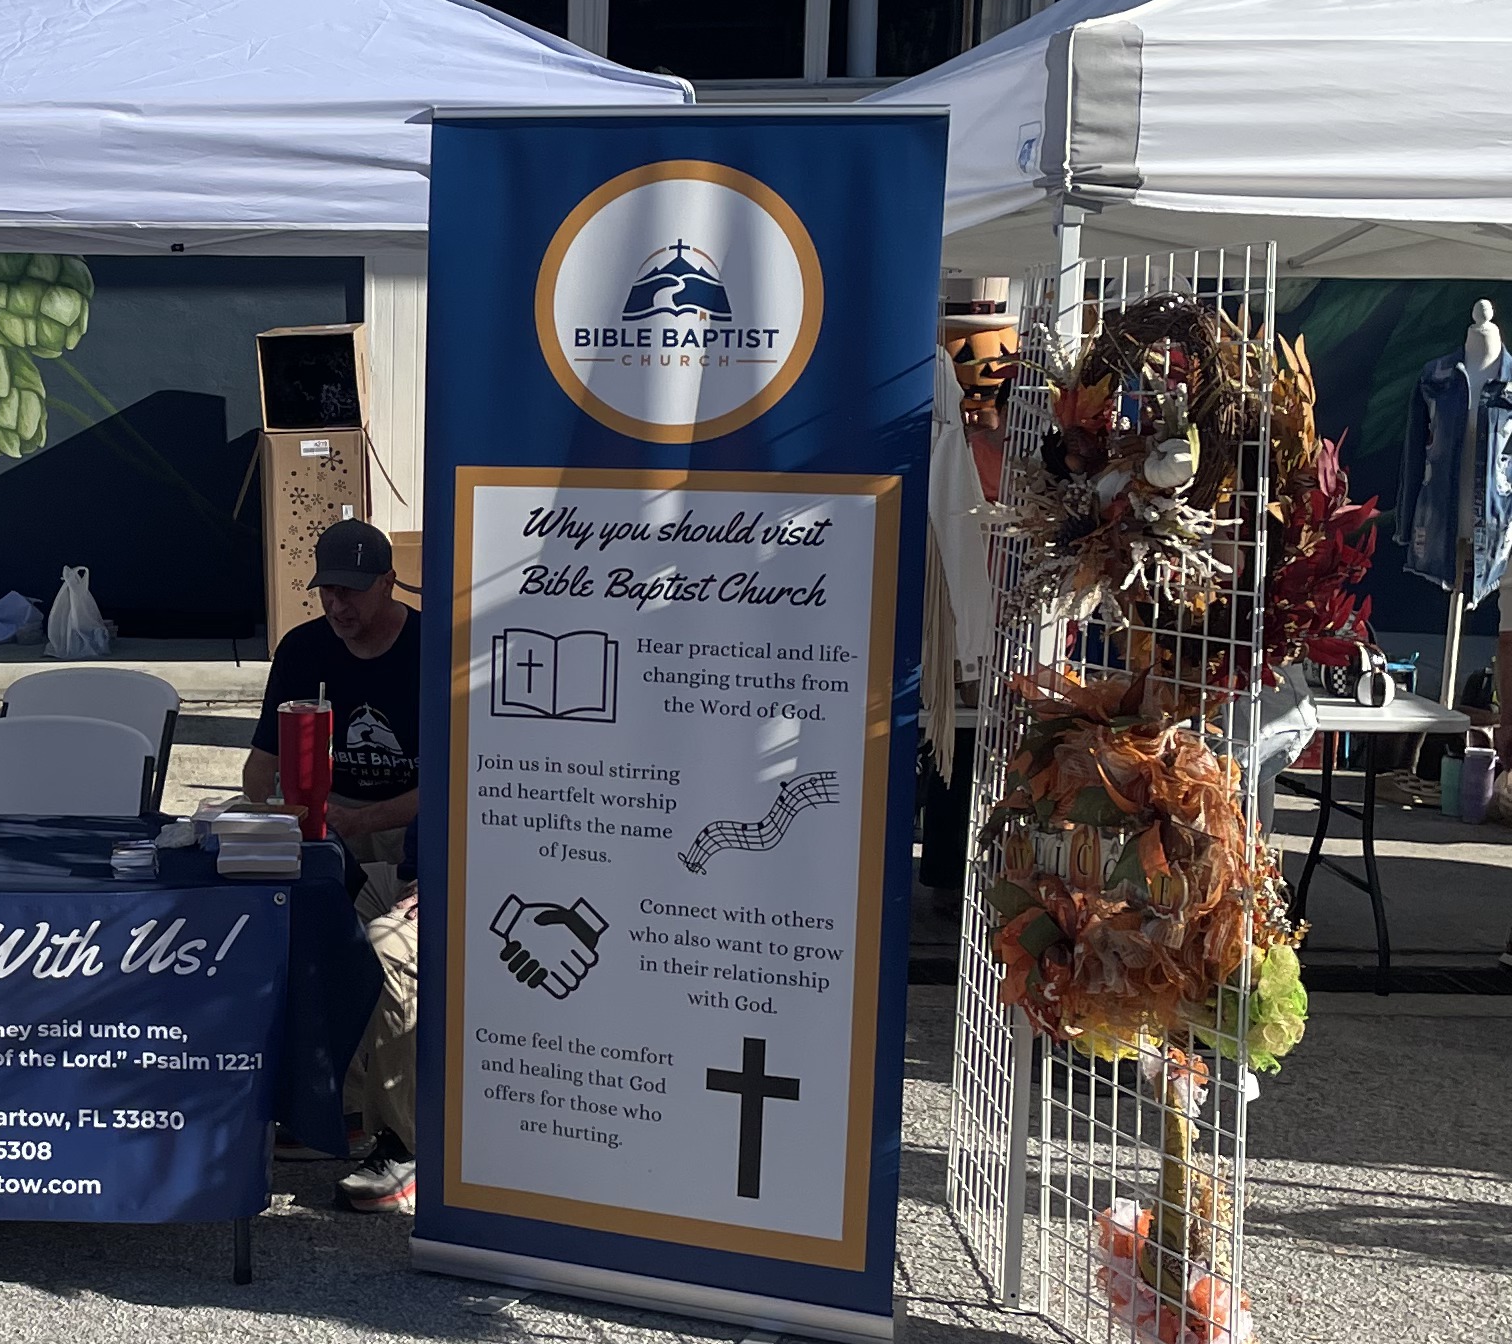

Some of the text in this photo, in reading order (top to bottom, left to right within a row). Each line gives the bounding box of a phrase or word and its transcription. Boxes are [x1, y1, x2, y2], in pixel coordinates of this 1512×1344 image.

[575, 328, 779, 348] BIBLE BAPTIST
[622, 355, 729, 367] CHURCH
[523, 507, 833, 551] Why you should visit
[519, 564, 826, 612] Bible Baptist Church
[637, 638, 683, 654] Hear
[688, 642, 770, 659] practical
[777, 644, 813, 661] and
[643, 667, 848, 692] changing truths from
[665, 696, 825, 720] the Word of God.
[333, 751, 367, 765] IBLE
[477, 754, 680, 785] Join us in soul stirring
[478, 782, 676, 814] and heartfelt worship
[482, 809, 672, 839] that uplifts the name
[539, 842, 611, 863] of Jesus.
[640, 899, 833, 930] Connect with others
[121, 915, 249, 976] Us!
[629, 926, 844, 961] who also want to grow
[640, 955, 829, 993] in their relationship
[688, 991, 777, 1014] with God.
[38, 1019, 82, 1037] said
[90, 1023, 140, 1038] unto
[148, 1026, 187, 1042] me,
[19, 1049, 56, 1067] the
[476, 1028, 674, 1066] Come feel the comfort
[482, 1058, 666, 1094] and healing that God
[484, 1084, 661, 1121] offers for those who
[79, 1109, 107, 1127] FL
[113, 1110, 184, 1130] 33830
[520, 1119, 622, 1149] are hurting.
